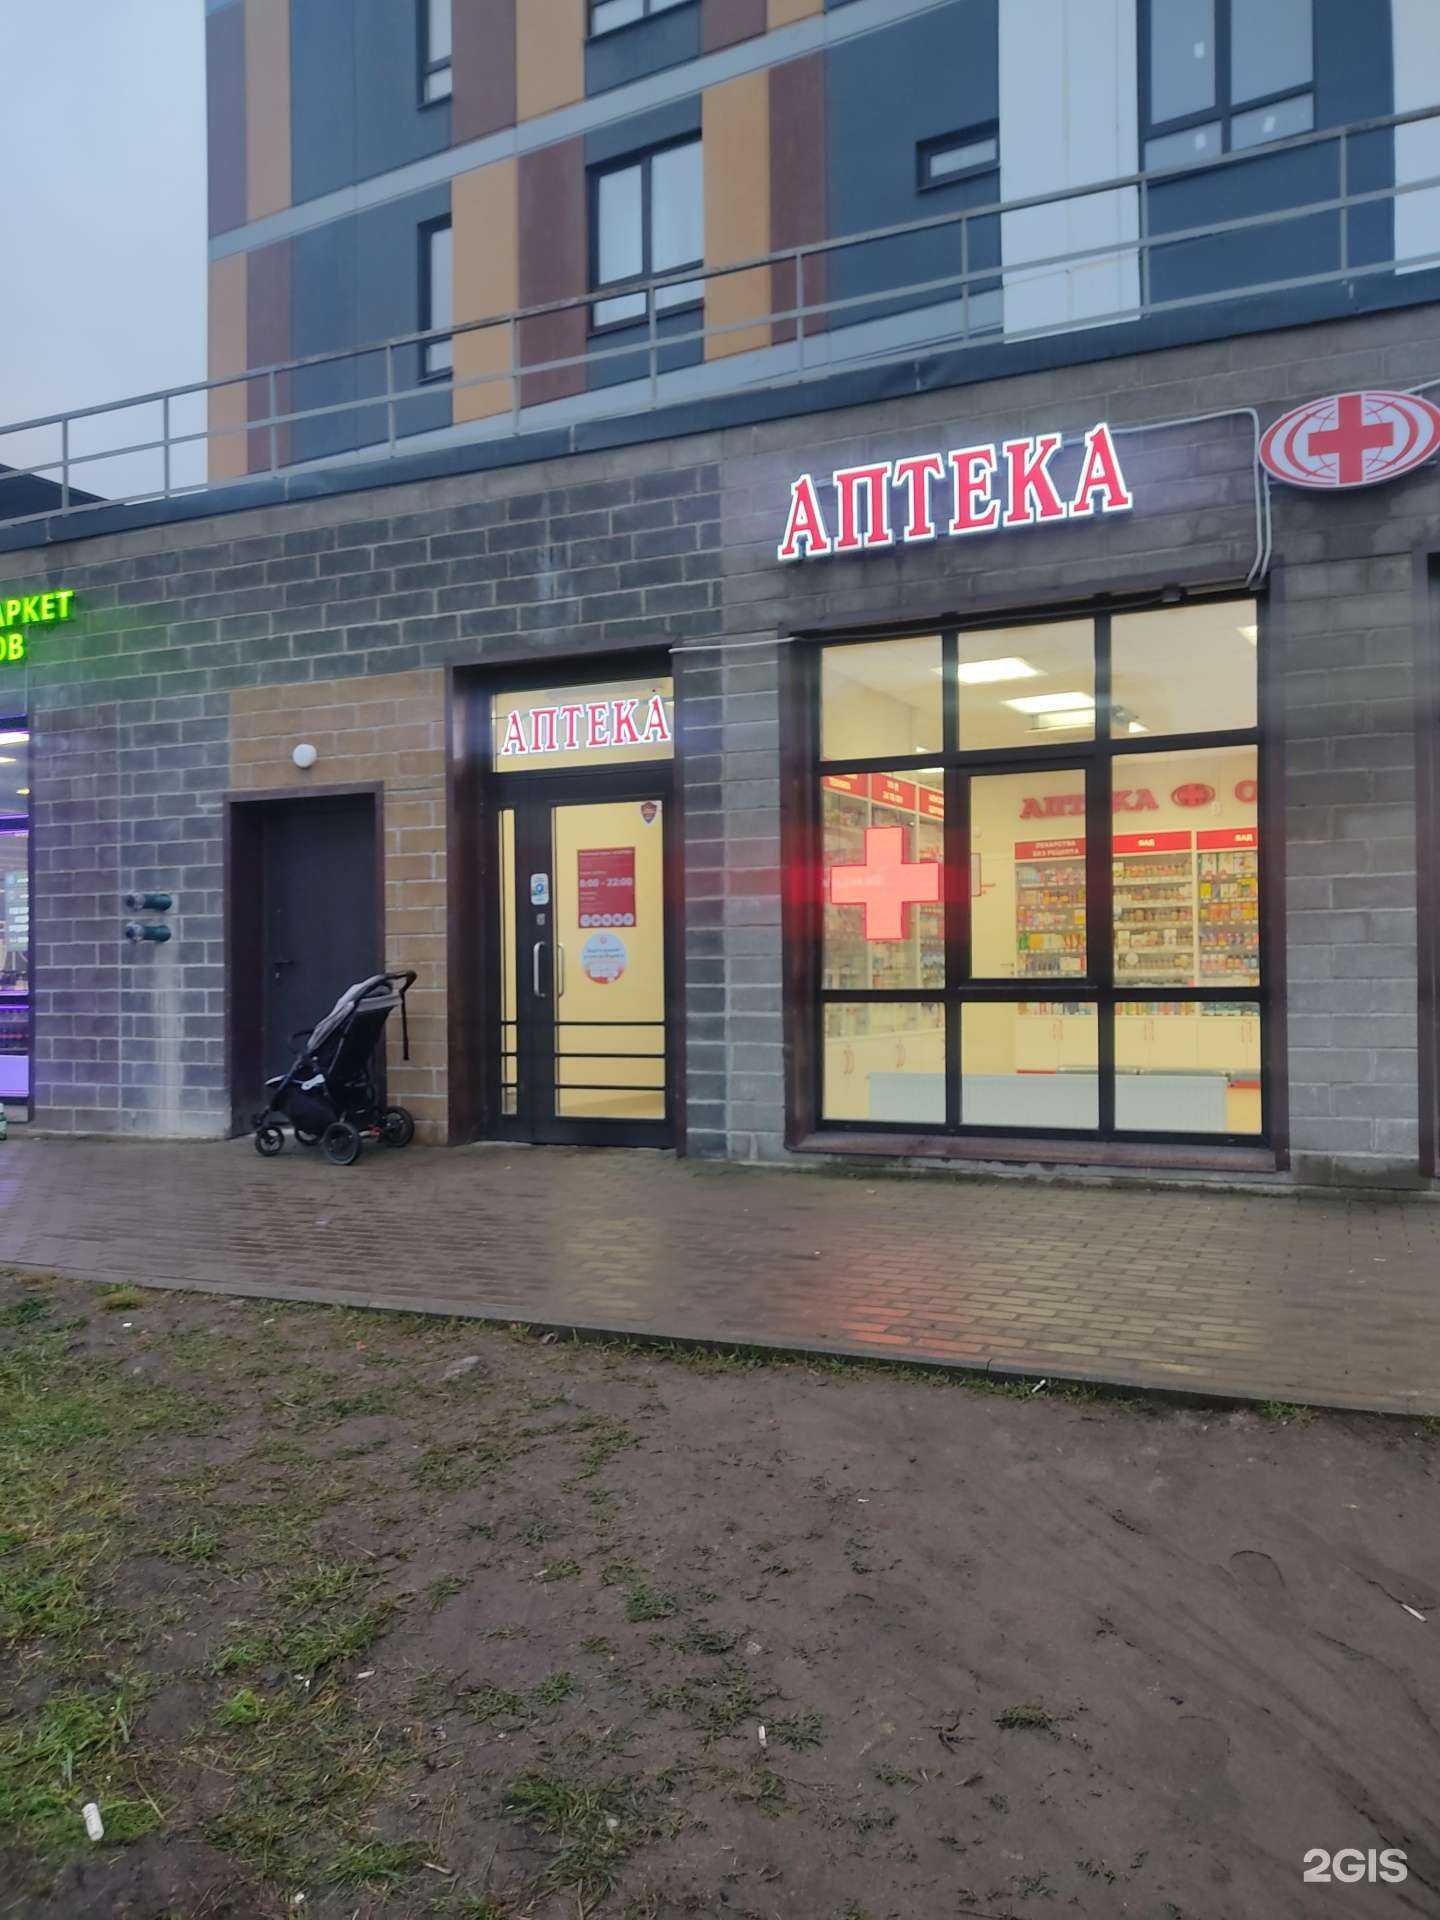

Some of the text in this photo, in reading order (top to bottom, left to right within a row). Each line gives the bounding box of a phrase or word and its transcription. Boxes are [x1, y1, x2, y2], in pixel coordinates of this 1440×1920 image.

[778, 422, 1133, 562] АПТЕКА
[501, 695, 671, 756] АПТЕКА
[1019, 788, 1160, 820] АПТКА
